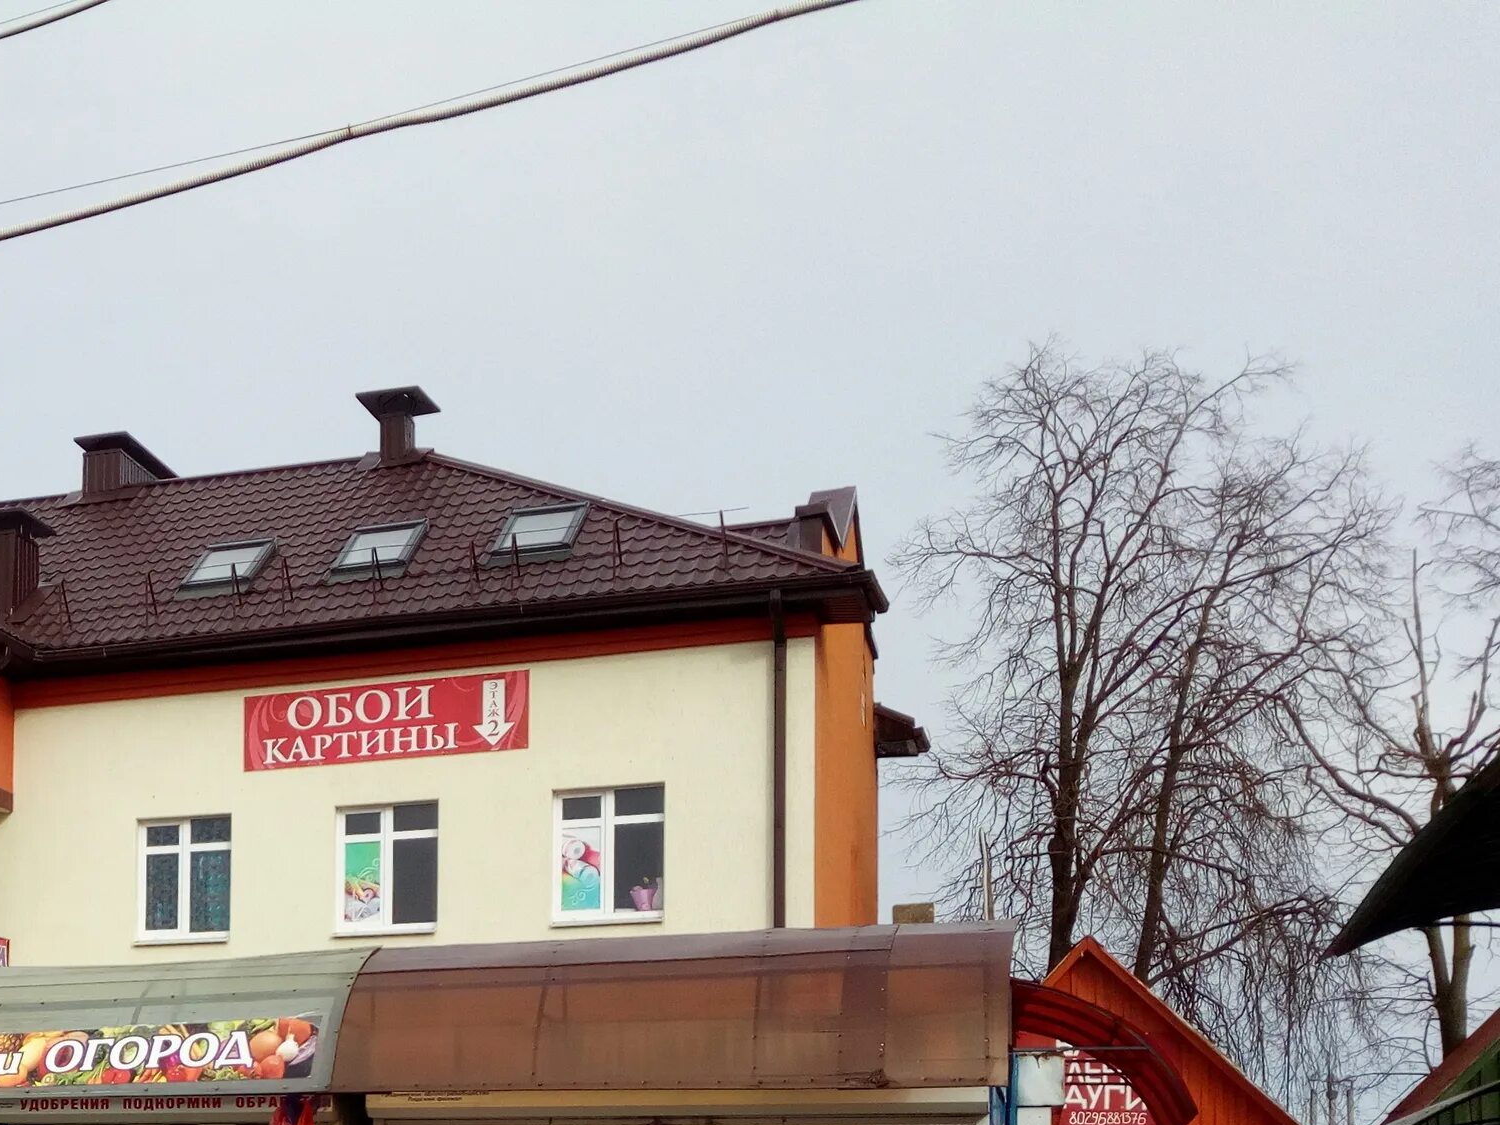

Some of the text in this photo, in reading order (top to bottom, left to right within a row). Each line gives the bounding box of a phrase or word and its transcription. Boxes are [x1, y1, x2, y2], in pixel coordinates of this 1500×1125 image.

[287, 685, 436, 731] ОБОИ
[487, 719, 500, 737] 2
[263, 722, 459, 765] КАРТИНЫ
[43, 1030, 255, 1074] ОГОРОД
[20, 1098, 109, 1112] УДОБРЕНИЯ
[122, 1096, 222, 1112] ПОДКОРМКИ
[1068, 1111, 1148, 1125] 80296881376
